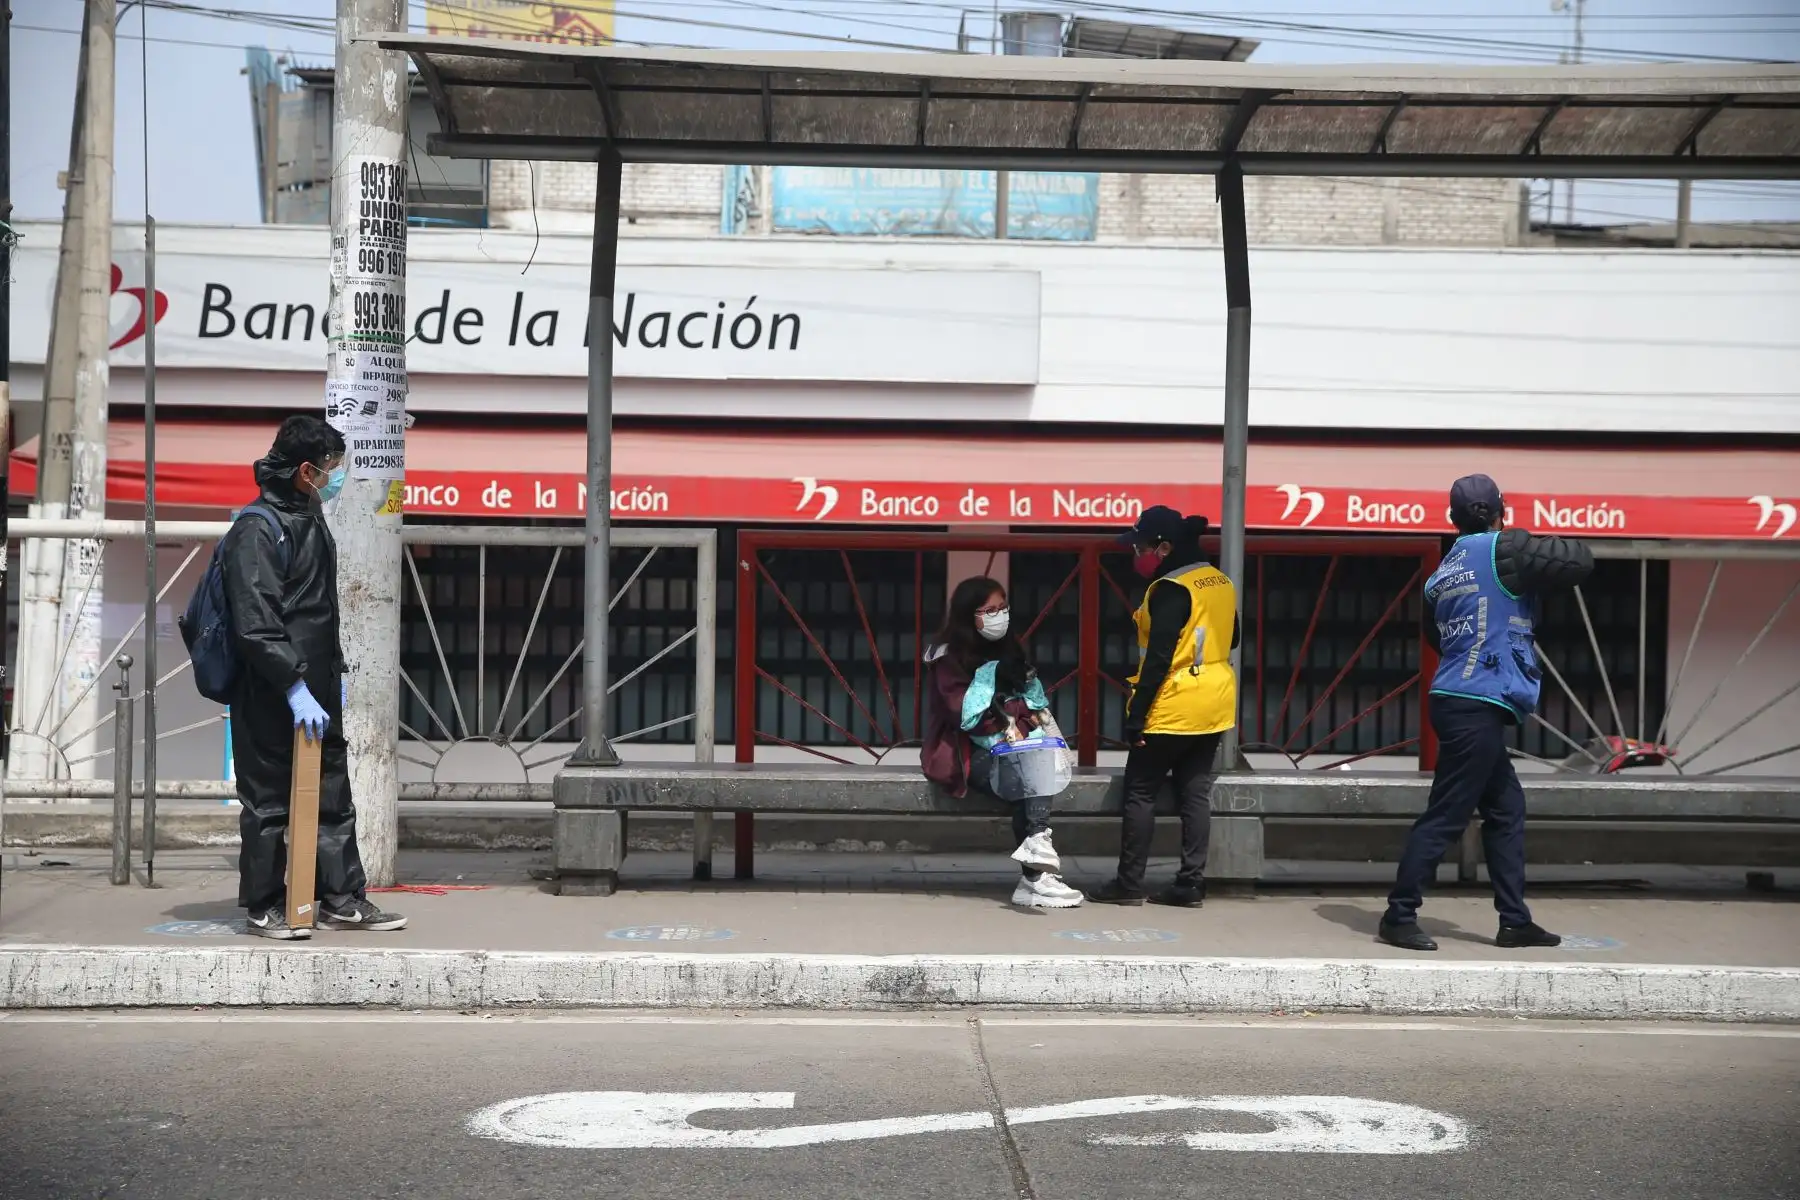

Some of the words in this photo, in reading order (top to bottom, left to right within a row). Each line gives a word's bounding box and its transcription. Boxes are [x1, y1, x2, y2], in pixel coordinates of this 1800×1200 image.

[361, 162, 386, 199] 993
[358, 249, 384, 274] 996
[198, 283, 332, 341] Ban
[414, 289, 484, 345] de
[508, 291, 559, 347] la
[584, 293, 801, 351] Nación
[354, 291, 379, 329] 993
[404, 484, 460, 506] anco
[481, 480, 513, 508] de
[535, 481, 557, 508] la
[578, 483, 669, 512] ción
[860, 487, 940, 517] Banco
[959, 489, 989, 517] de
[1009, 489, 1032, 517] la
[1053, 489, 1143, 519] Nación
[1346, 495, 1425, 524] Banco
[1533, 499, 1626, 529] Nación
